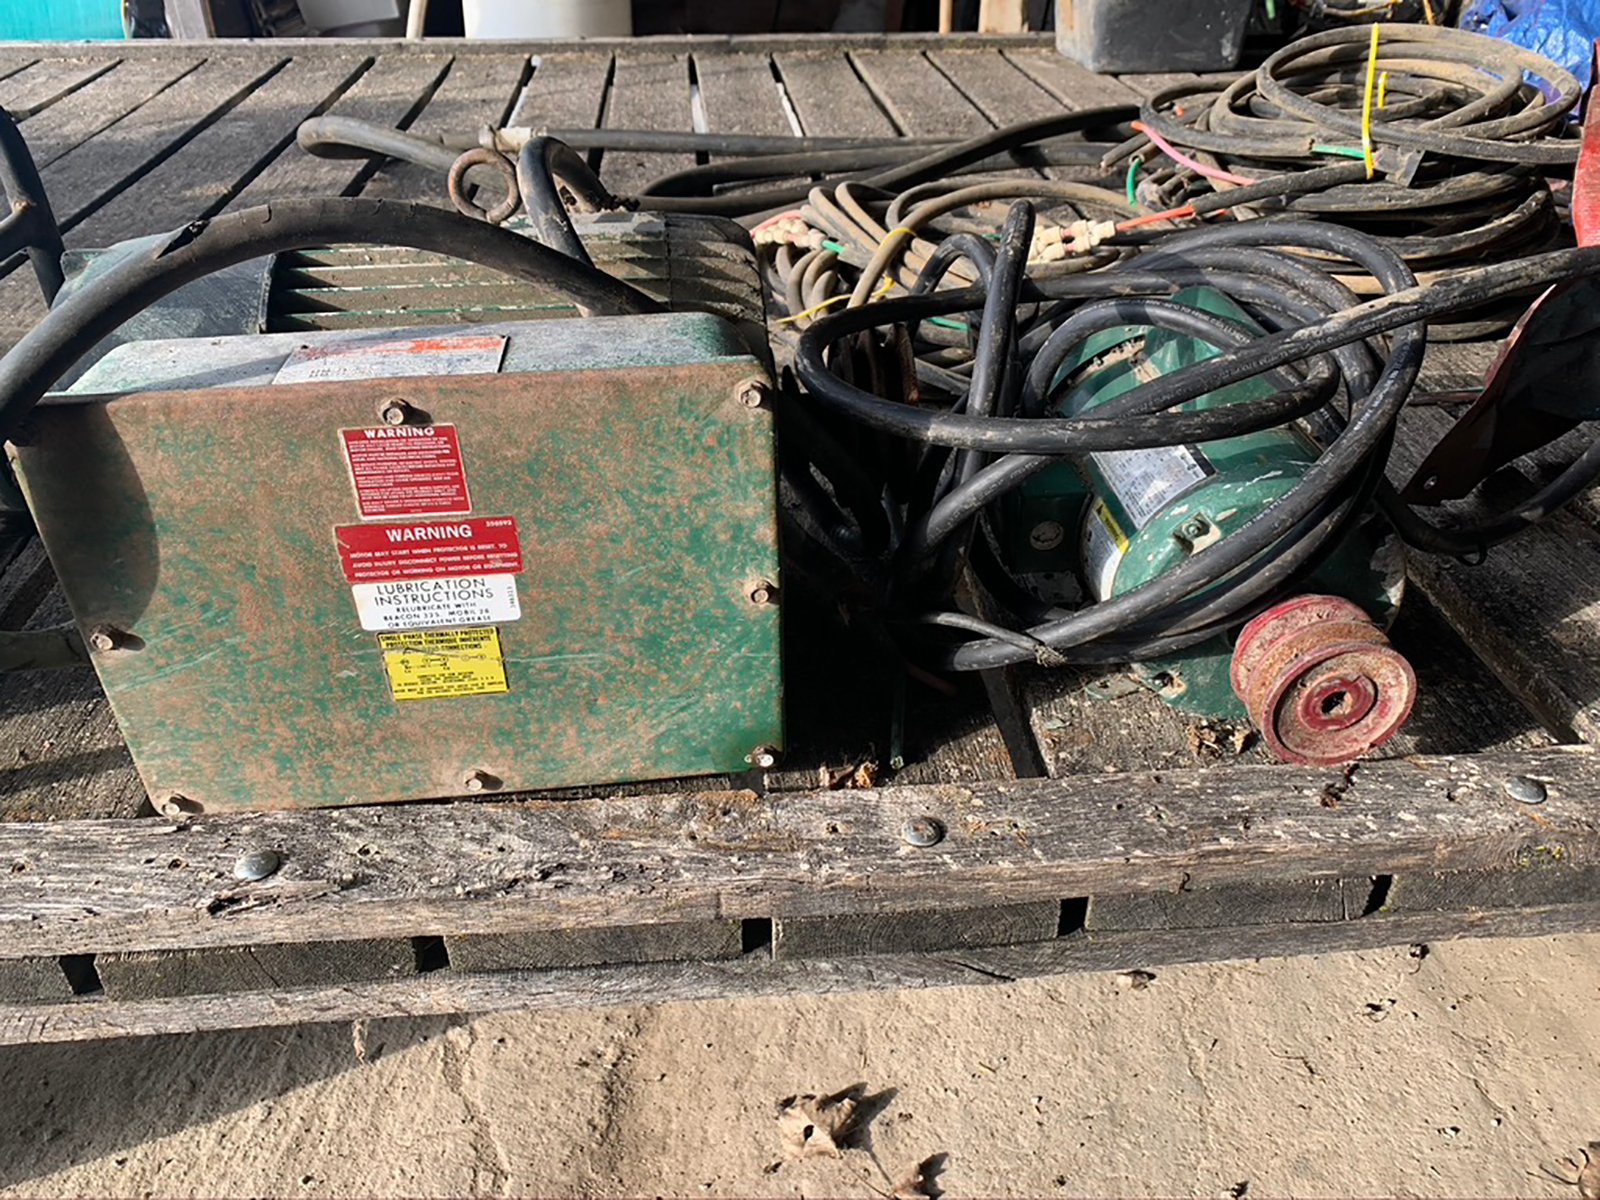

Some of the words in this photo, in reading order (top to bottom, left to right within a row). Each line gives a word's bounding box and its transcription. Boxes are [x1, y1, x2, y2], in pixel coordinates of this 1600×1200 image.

[364, 427, 435, 438] WARNING
[386, 524, 472, 542] WARNING
[398, 557, 437, 565] DISCONNECT
[354, 570, 390, 578] PROTECTOR
[376, 578, 486, 595] LUBRICATION
[374, 588, 494, 606] INSTRUCTIONS
[396, 604, 450, 612] RELUBRICATE
[384, 613, 420, 621] BEACON
[402, 618, 456, 626] EQUIVALENT
